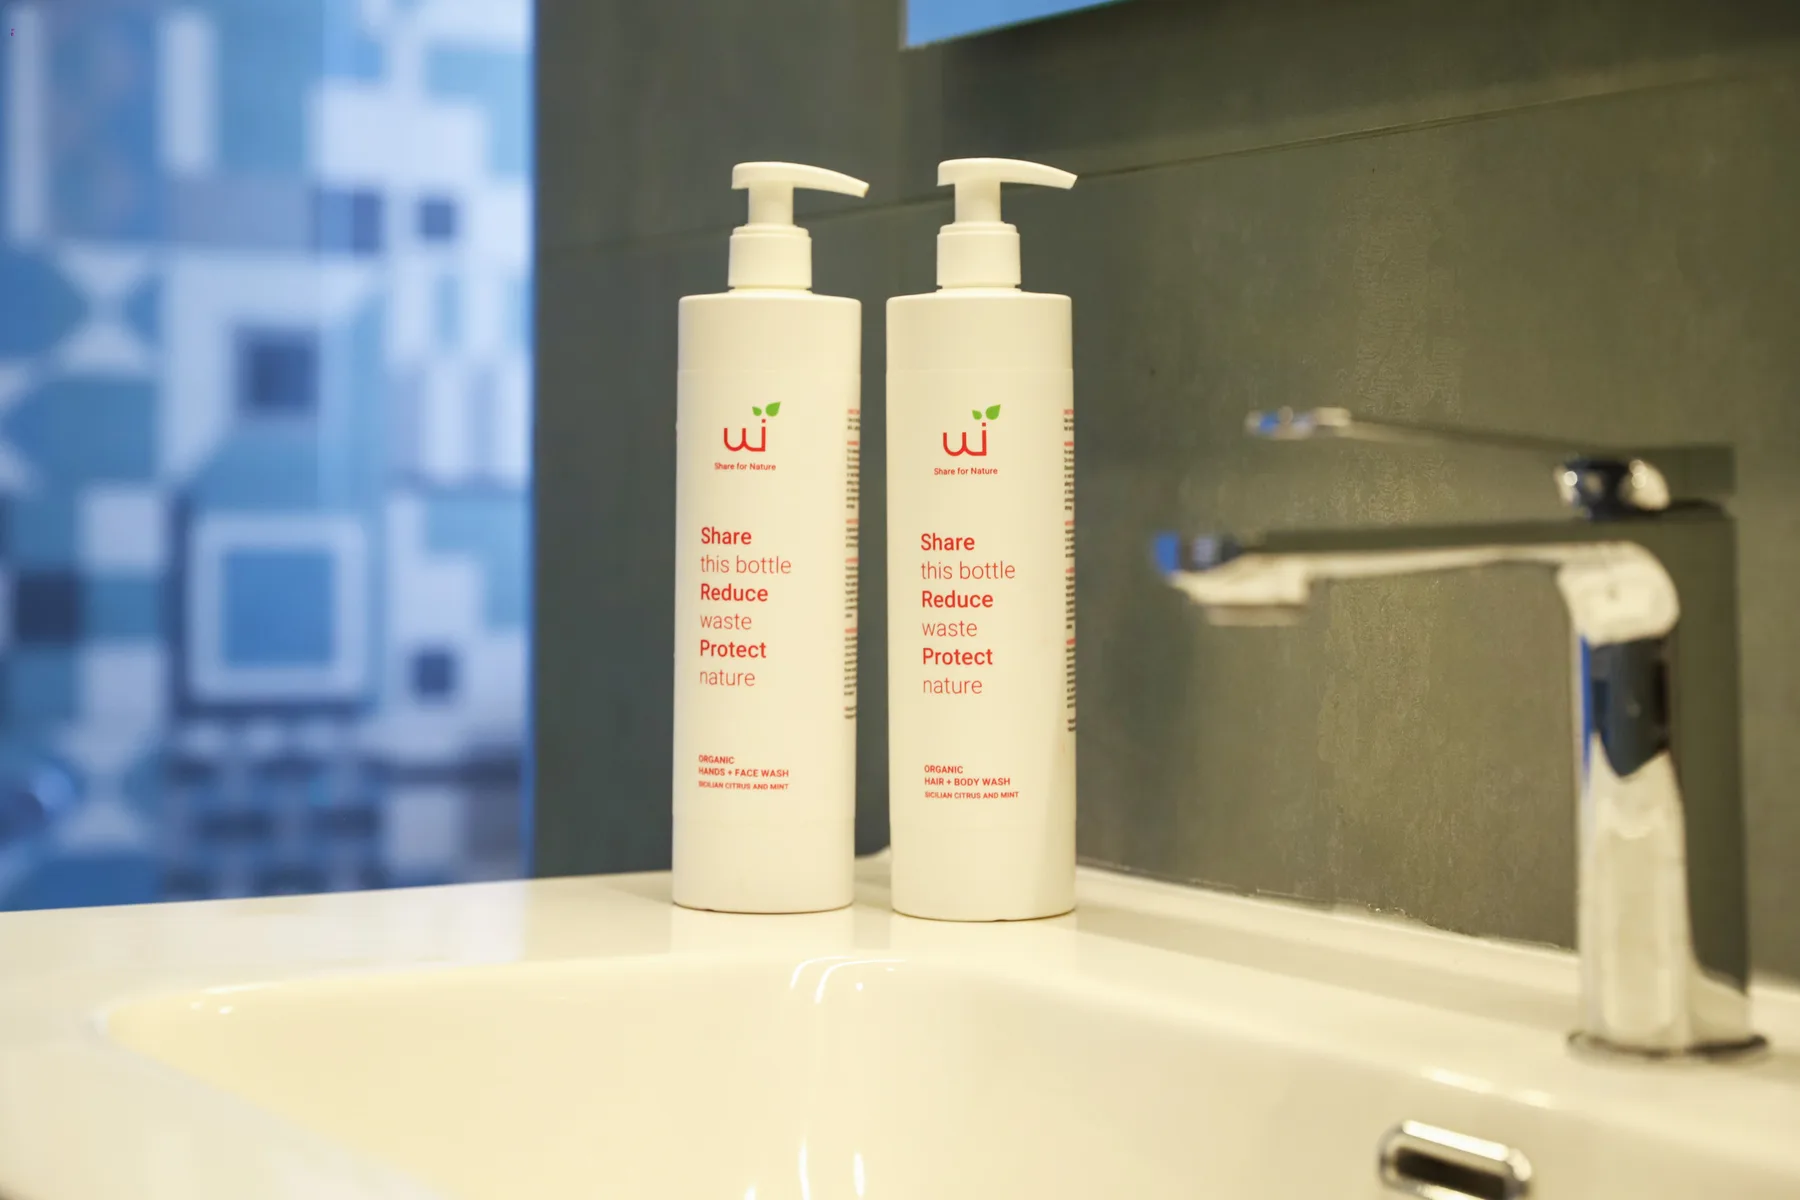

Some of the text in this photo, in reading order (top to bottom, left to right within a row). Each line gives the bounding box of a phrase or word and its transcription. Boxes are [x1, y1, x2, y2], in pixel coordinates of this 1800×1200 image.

[714, 462, 776, 471] Share for Nature
[933, 467, 998, 475] Share for Nature
[700, 526, 753, 546] Share
[920, 532, 976, 552] Share
[700, 555, 792, 575] this bottle
[921, 561, 1016, 581] this bottle
[699, 582, 769, 603] Reduce
[921, 589, 994, 609] Reduce
[700, 613, 753, 630] waste
[921, 620, 979, 638] waste
[699, 638, 767, 659] Protect
[922, 647, 993, 667] Protect
[700, 669, 756, 687] nature
[923, 677, 983, 695] nature
[698, 754, 735, 764] ORGANIC
[698, 767, 725, 776] HANDS
[735, 769, 759, 777] FACE
[761, 769, 789, 777] WASH
[924, 765, 963, 774] ORGANIC
[725, 782, 751, 790] CITRUS
[924, 777, 944, 786] HAIR
[954, 778, 979, 786] BODY
[982, 778, 1011, 786] WASH
